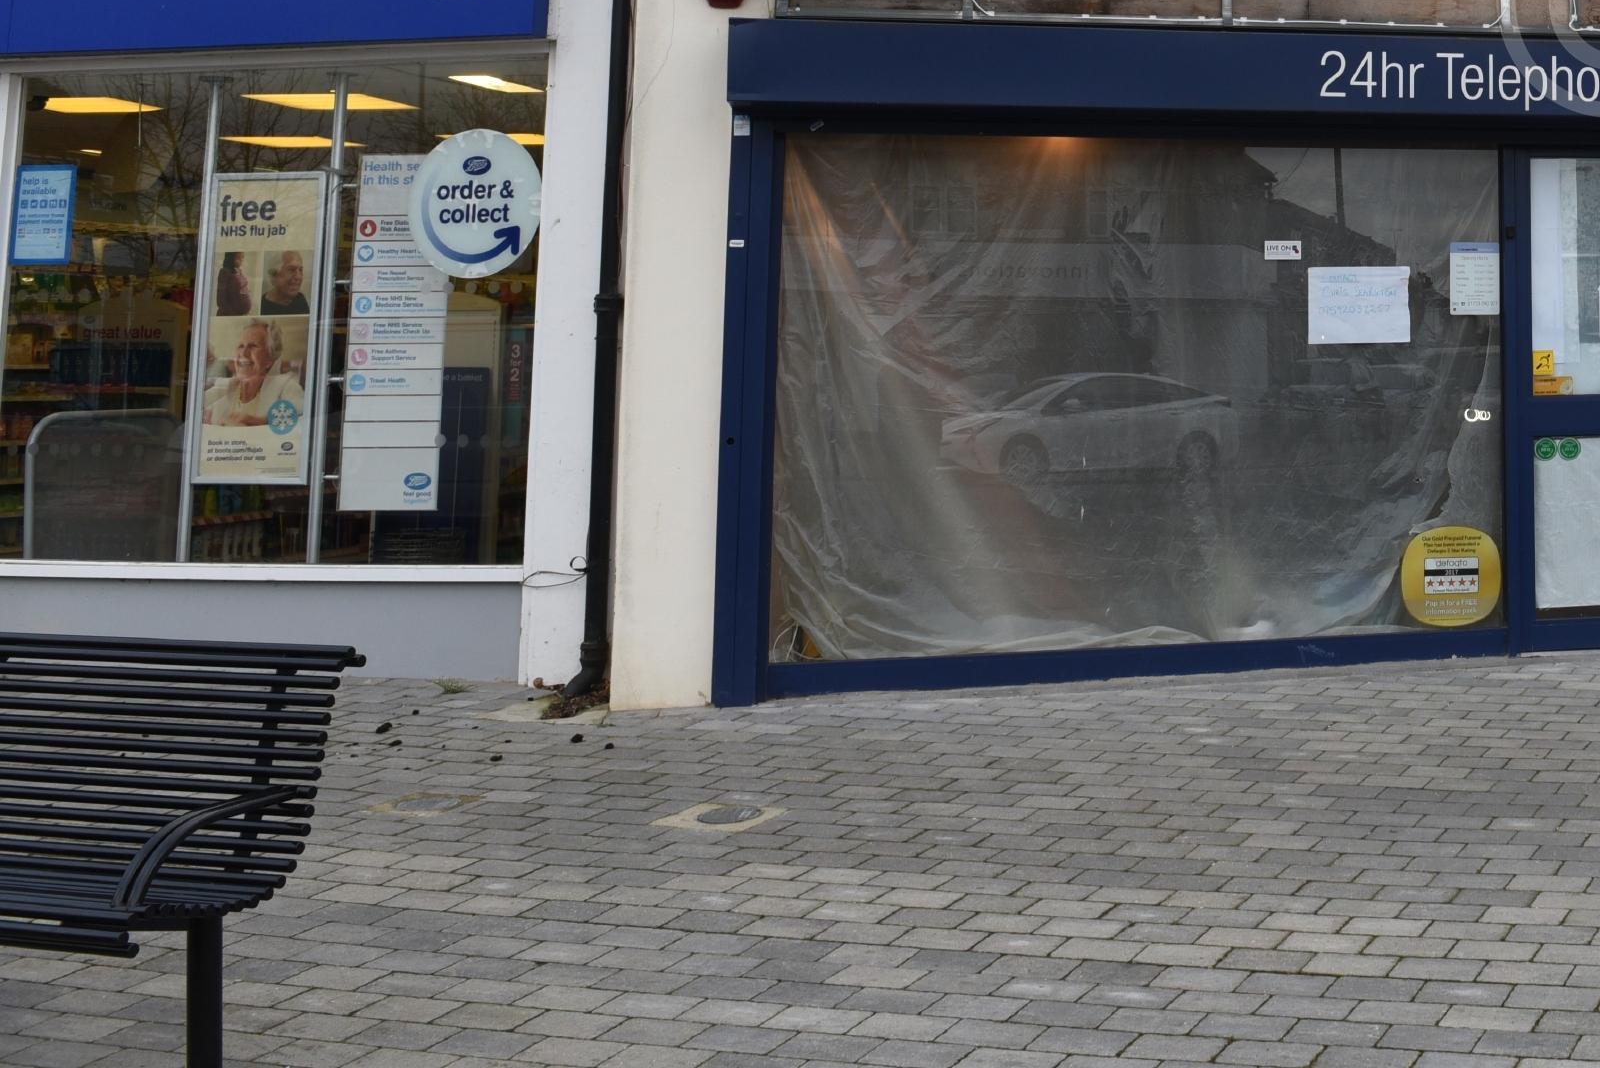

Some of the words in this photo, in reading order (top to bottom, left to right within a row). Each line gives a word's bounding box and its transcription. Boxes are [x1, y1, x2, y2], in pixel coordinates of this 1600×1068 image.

[1320, 50, 1424, 99] 24hr
[364, 160, 403, 172] Health
[22, 177, 40, 186] help
[363, 175, 374, 185] in
[378, 174, 400, 185] this
[21, 187, 57, 195] available
[437, 180, 496, 200] order
[500, 180, 514, 199] &
[220, 194, 277, 222] free
[439, 203, 510, 224] collect
[221, 225, 247, 237] NHS
[250, 224, 265, 236] flu
[83, 326, 120, 340] great
[124, 325, 162, 339] value
[511, 344, 520, 358] 3
[510, 368, 520, 382] 2
[1435, 559, 1468, 567] defaqto
